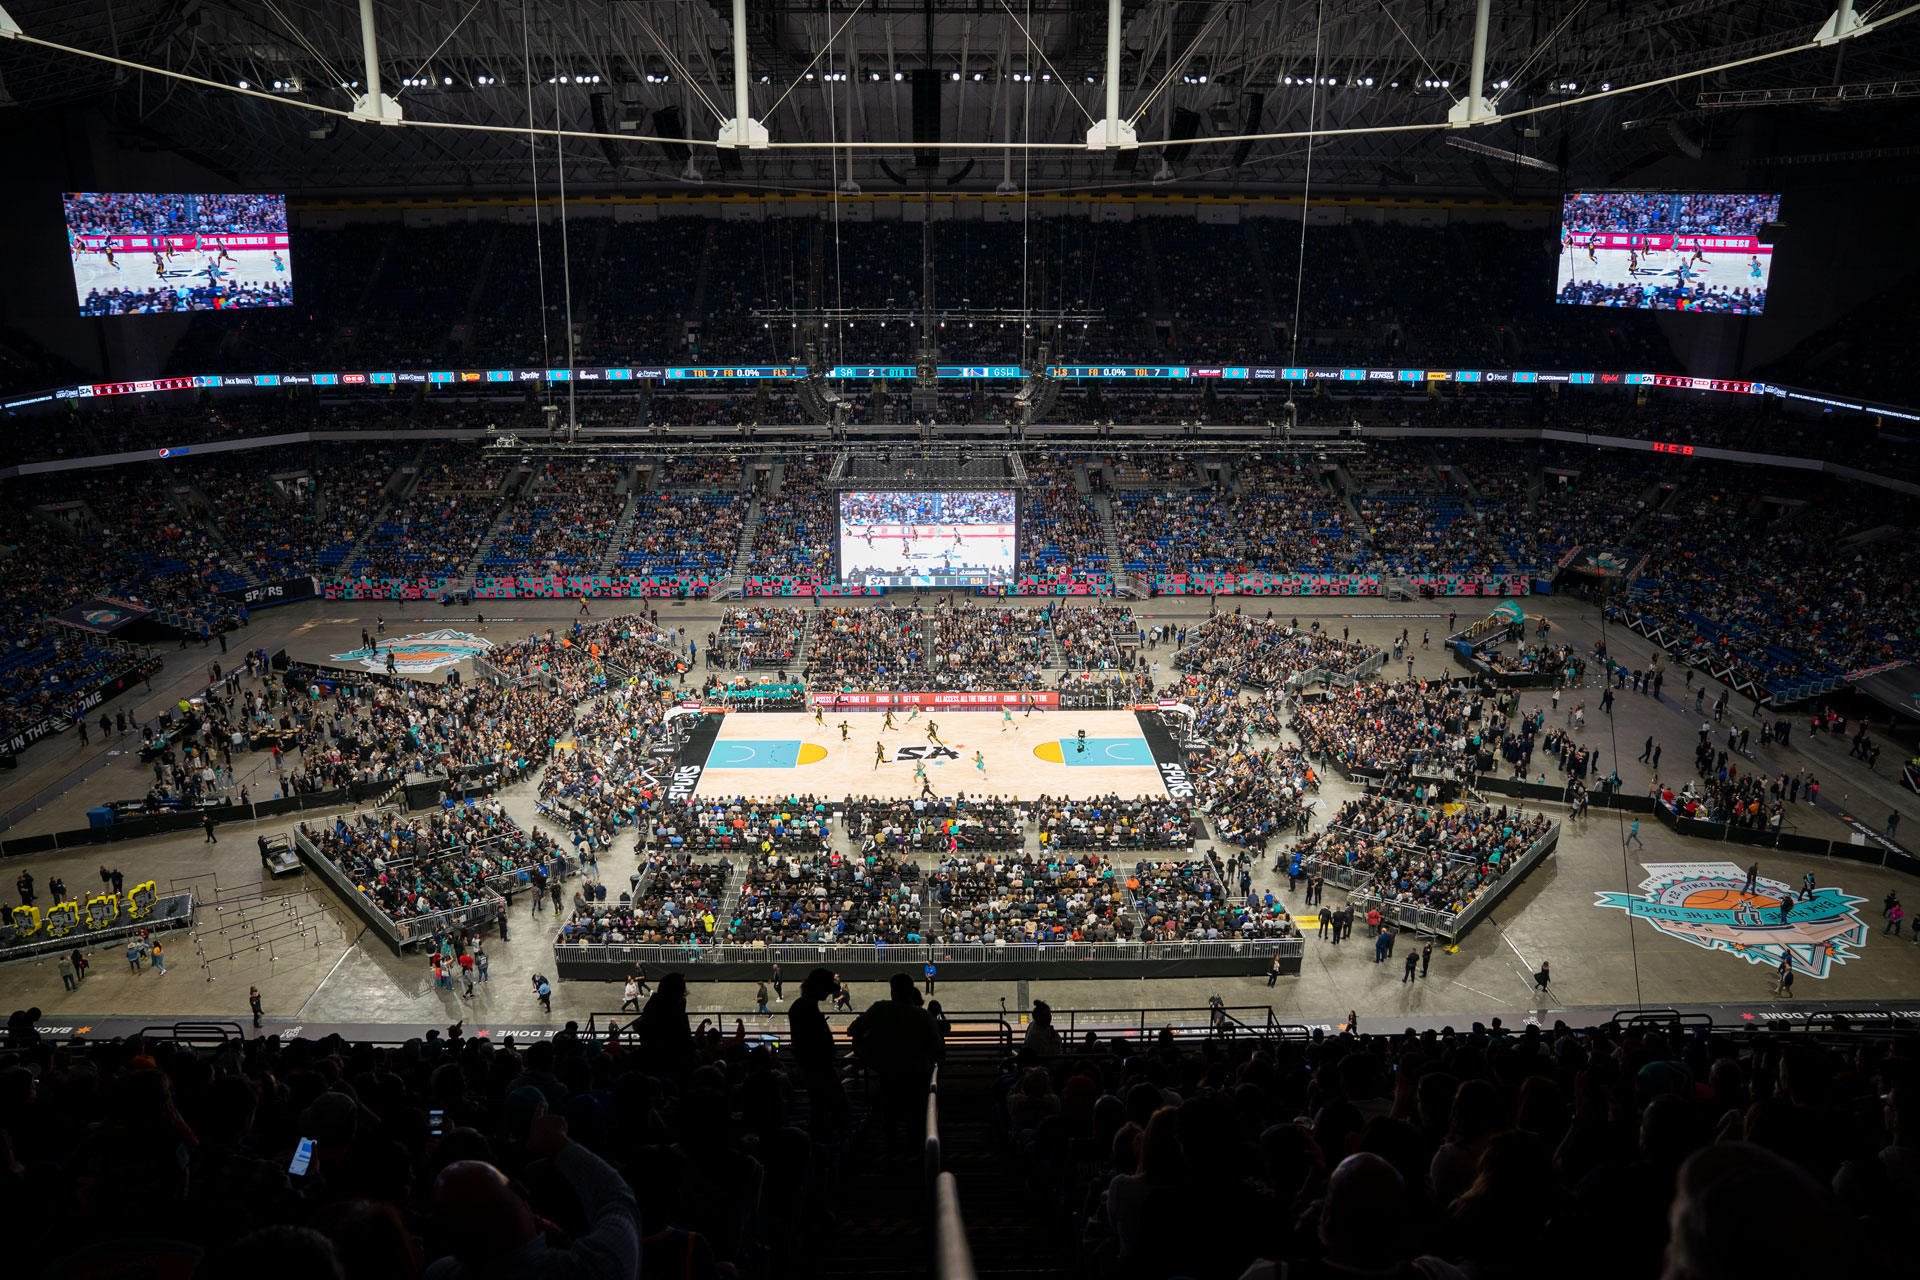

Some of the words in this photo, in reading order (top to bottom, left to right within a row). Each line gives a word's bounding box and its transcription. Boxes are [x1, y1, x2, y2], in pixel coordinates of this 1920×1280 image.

[520, 371, 539, 380] Sprite
[736, 369, 759, 377] 0.0%
[773, 369, 787, 377] FLS
[868, 369, 874, 377] 2
[994, 368, 1014, 376] GSW
[1088, 368, 1098, 376] FG
[1103, 368, 1126, 376] 0.0%
[1134, 368, 1148, 376] TOL
[1154, 368, 1160, 376] 7
[1653, 442, 1694, 455] H-E-B
[871, 577, 886, 586] SA
[245, 586, 283, 602] SPURS
[10, 734, 26, 751] IN
[25, 719, 50, 741] THE
[72, 691, 103, 712] OME
[897, 746, 960, 761] SA
[668, 765, 701, 800] SPURS
[1160, 762, 1194, 797] SPURS
[1684, 882, 1737, 892] ANTONIO
[1635, 904, 1678, 917] DOME
[1805, 900, 1837, 913] BACK
[1683, 911, 1712, 920] THE
[1758, 1012, 1805, 1020] DOME
[496, 1030, 542, 1038] DOME
